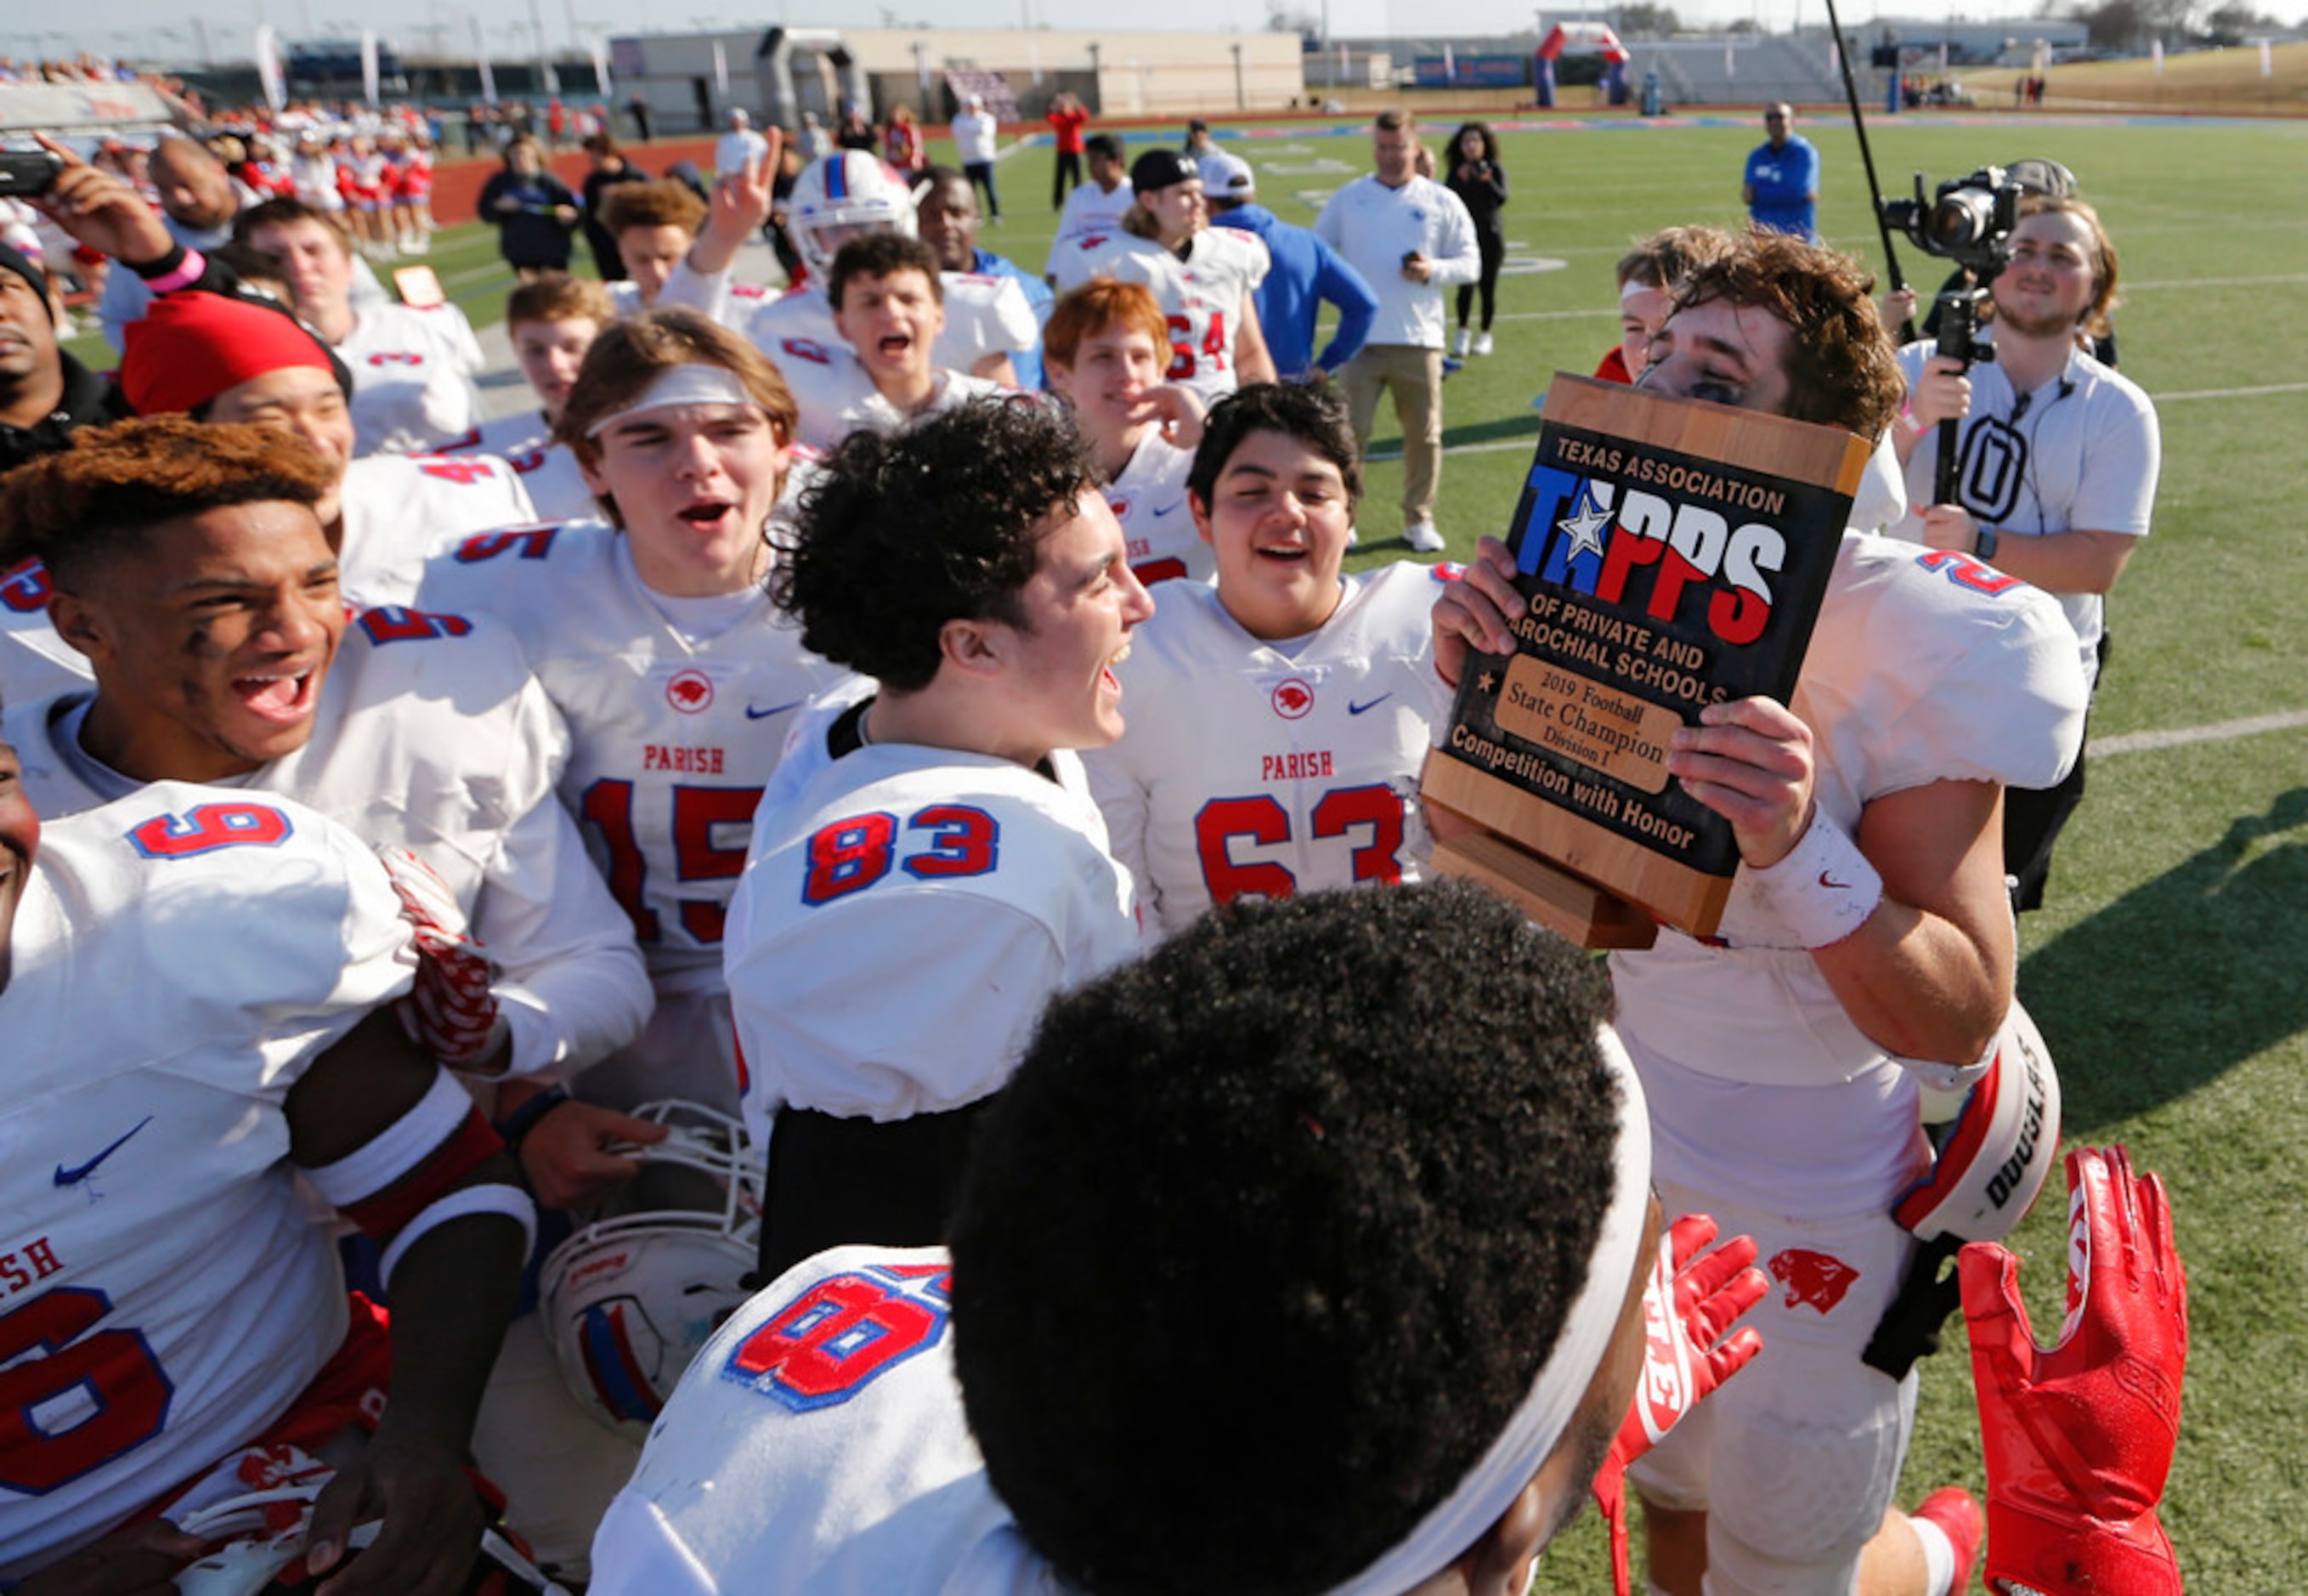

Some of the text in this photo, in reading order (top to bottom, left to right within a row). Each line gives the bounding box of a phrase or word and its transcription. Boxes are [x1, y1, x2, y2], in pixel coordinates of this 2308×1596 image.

[1557, 437, 1785, 516] TEXAS ASSOCIATION
[1516, 464, 1785, 645] TAPPS
[1506, 615, 1610, 670] AROCHIAL
[1530, 594, 1705, 671] OF PRIVATE AND
[1508, 682, 1665, 763] State Champion
[1541, 671, 1645, 724] 2019 Football
[643, 744, 725, 773] PARISH
[1262, 750, 1334, 781] PARISH
[1543, 725, 1611, 767] Division I
[1452, 724, 1695, 849] Competition with Honor
[580, 777, 765, 945] 15
[801, 805, 1000, 907] 83
[1194, 782, 1405, 906] 63
[1984, 1033, 2045, 1210] DOUGLAS
